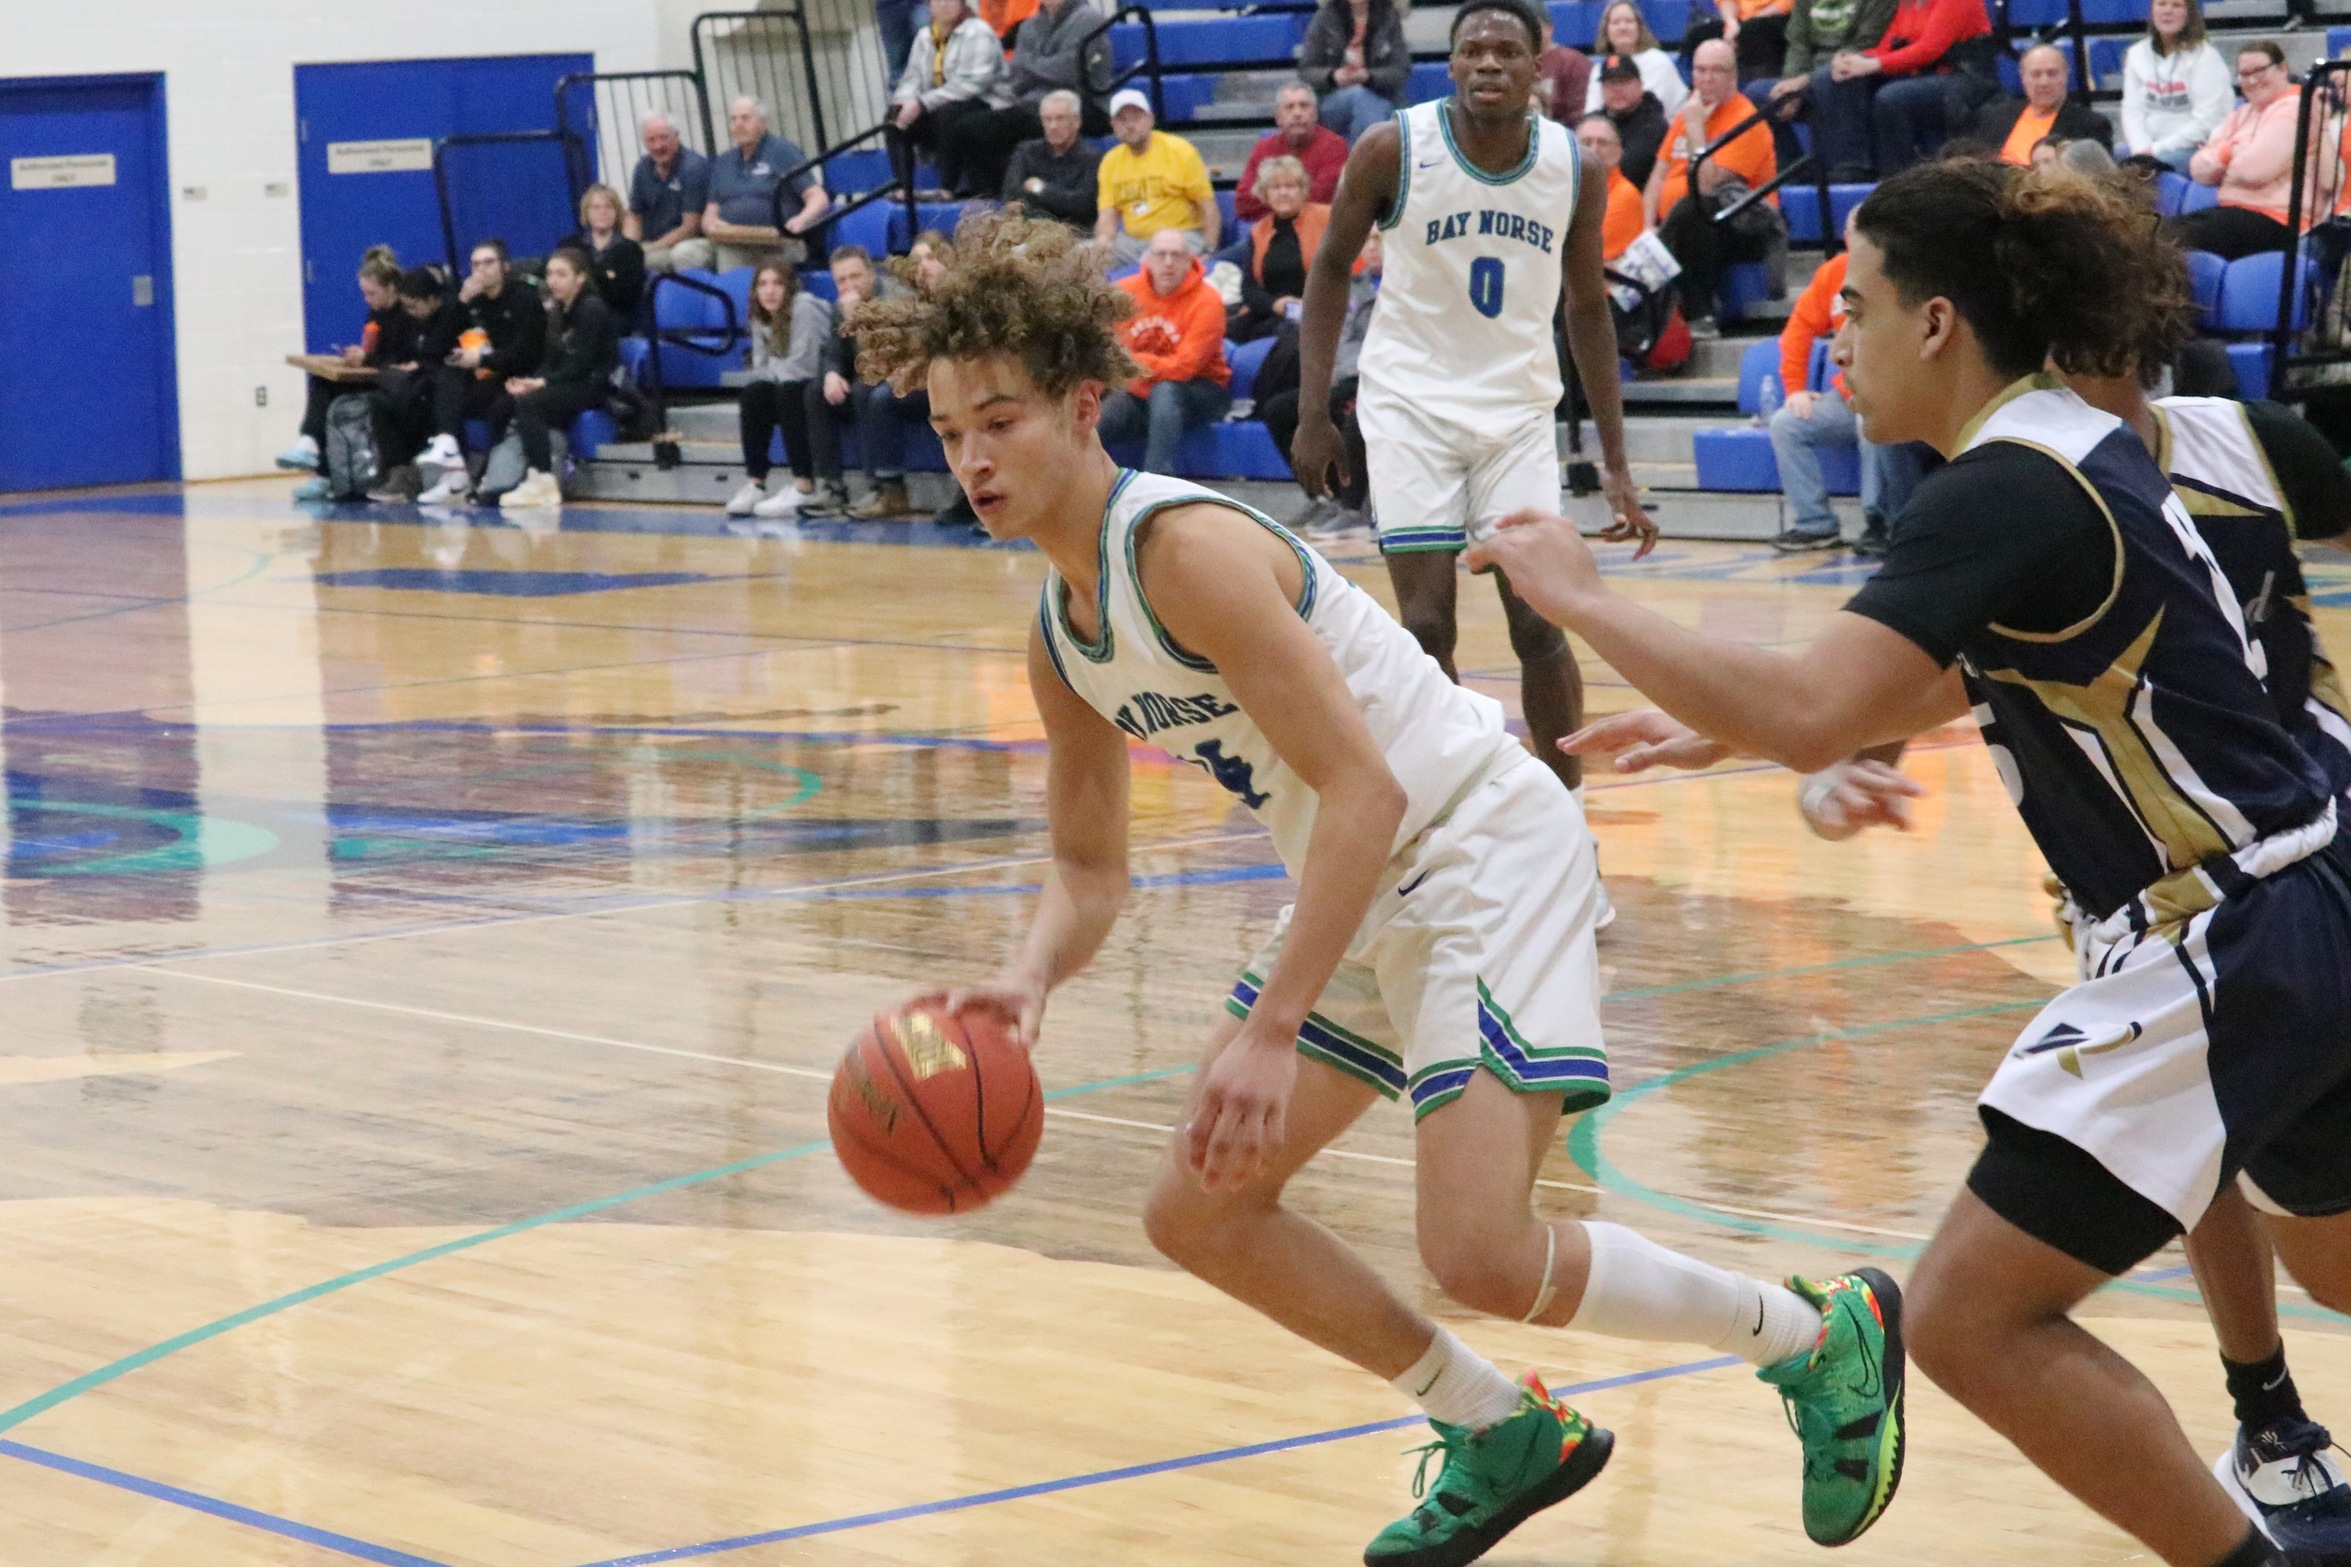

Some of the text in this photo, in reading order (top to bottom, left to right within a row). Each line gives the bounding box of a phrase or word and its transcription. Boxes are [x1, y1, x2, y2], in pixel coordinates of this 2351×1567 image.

[1426, 210, 1554, 254] BAY NORSE
[1469, 256, 1505, 319] 0
[1130, 690, 1240, 734] NORSE
